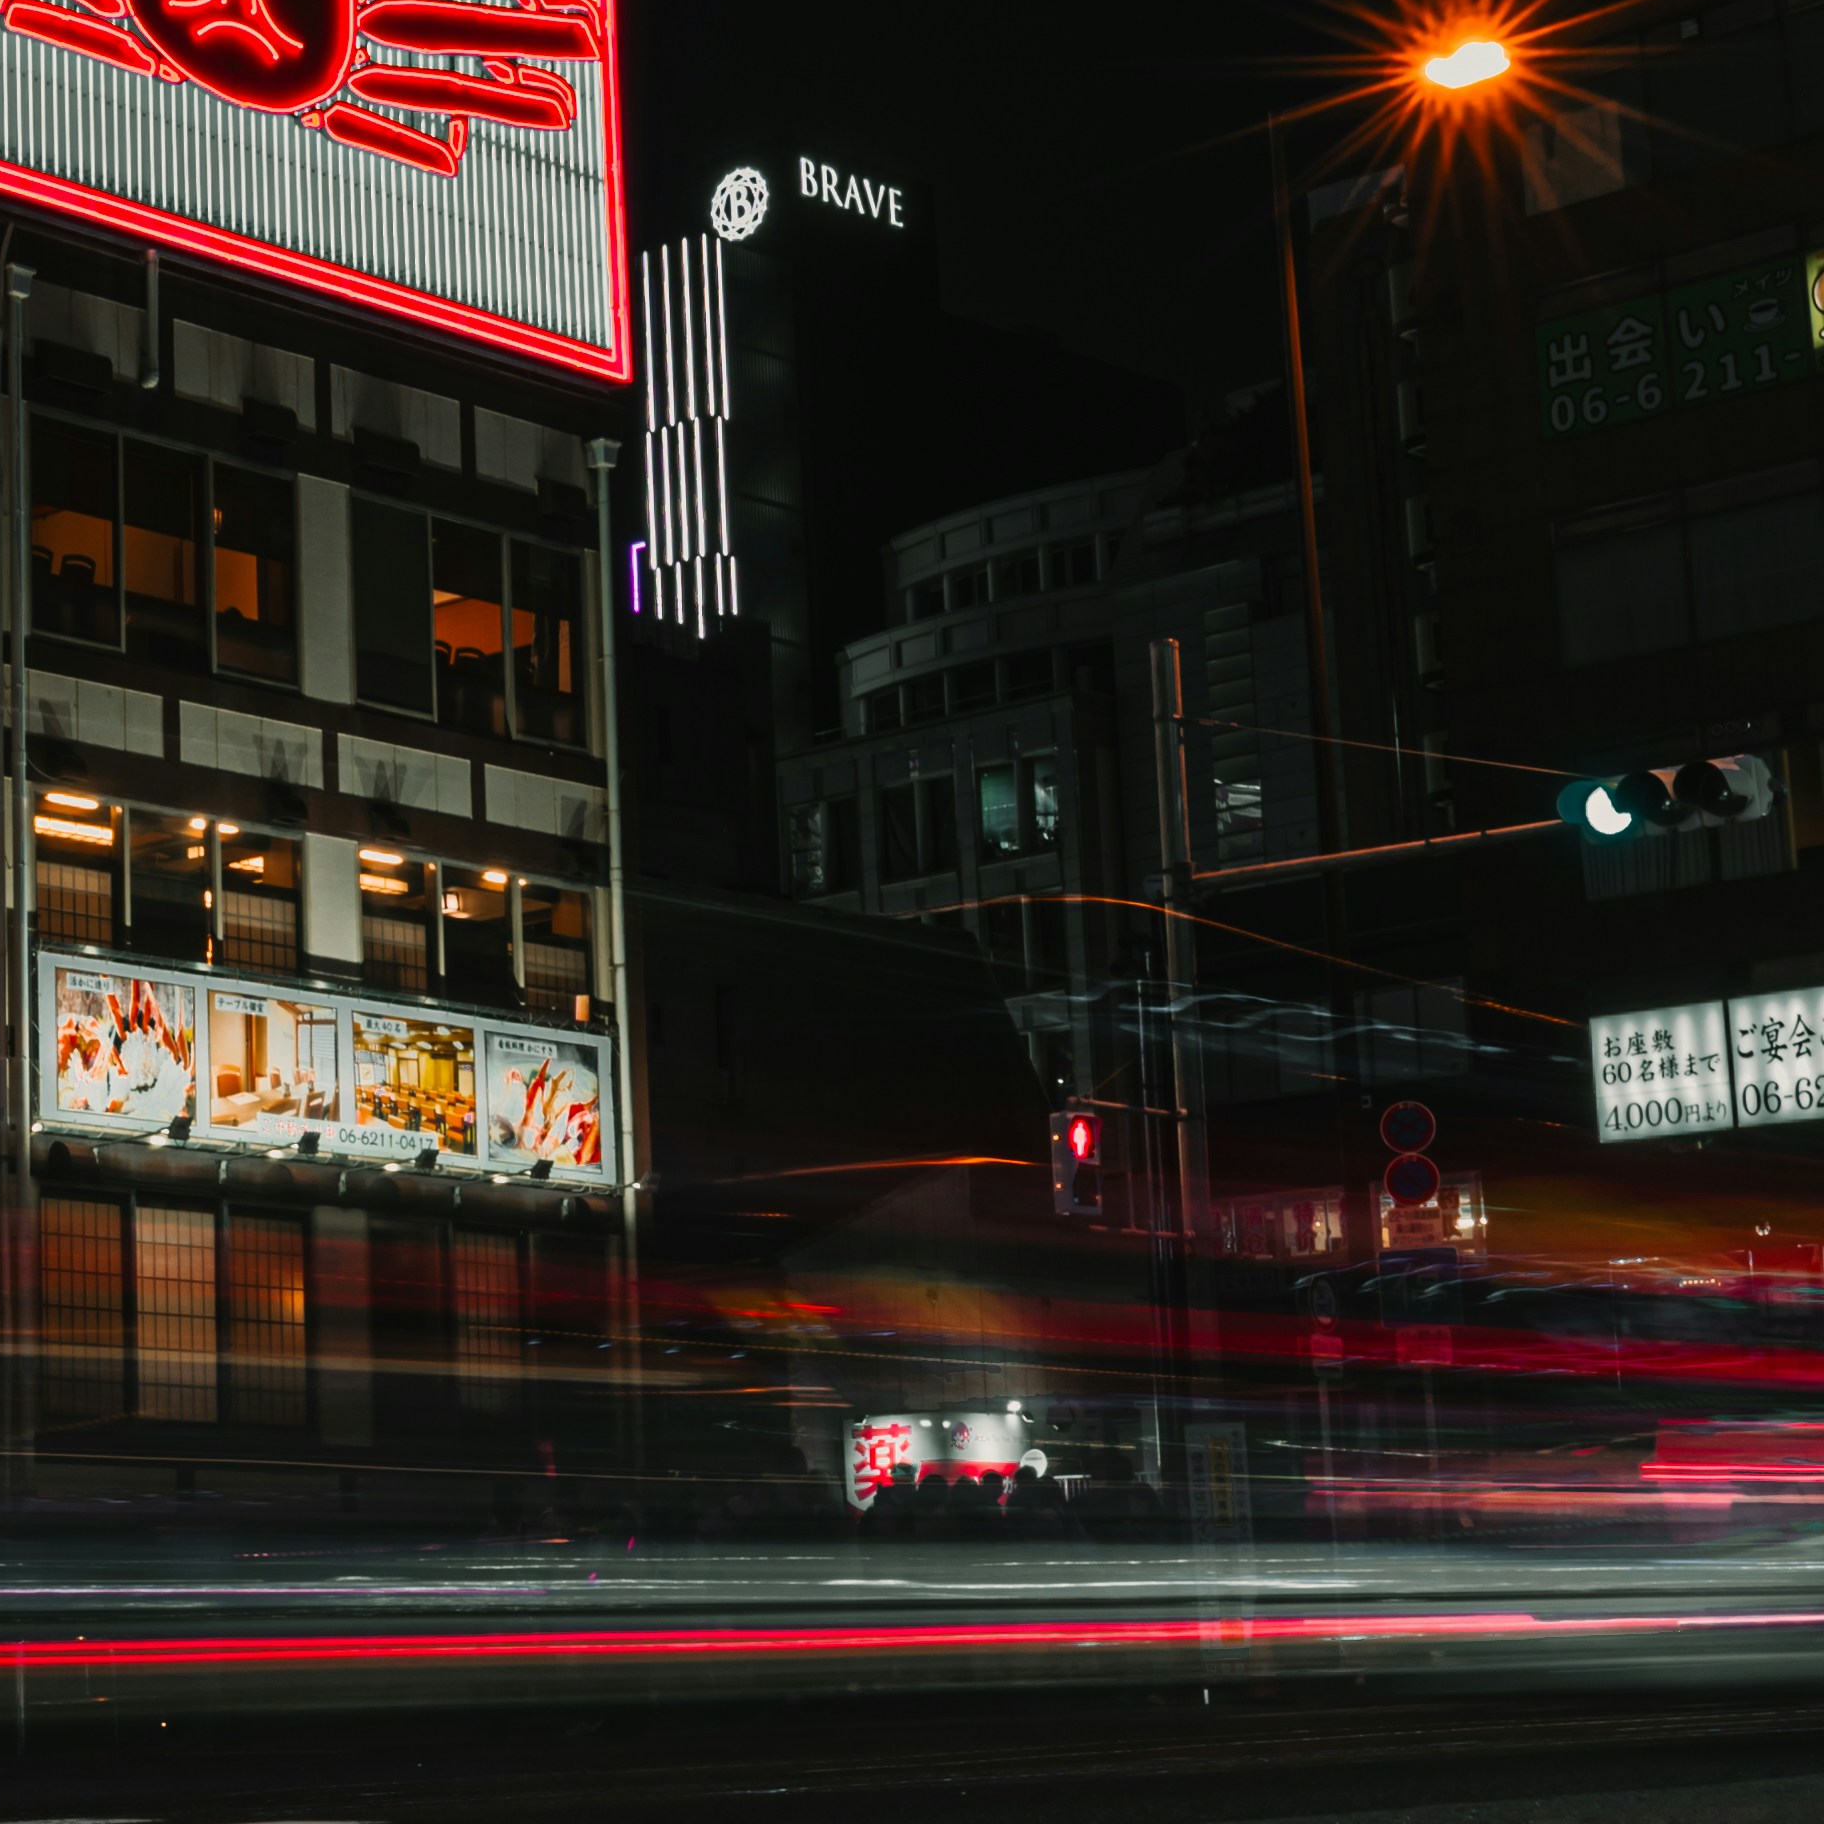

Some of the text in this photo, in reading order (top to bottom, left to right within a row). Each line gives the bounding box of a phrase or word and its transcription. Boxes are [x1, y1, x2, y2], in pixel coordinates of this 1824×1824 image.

[799, 156, 905, 228] BRAVE
[1547, 304, 1726, 388] 出会い
[1603, 1028, 1675, 1058] お座敷
[1736, 1013, 1824, 1064] ご宴会
[1602, 1052, 1721, 1085] 60名様まで
[1604, 1097, 1727, 1132] 4,000円より
[338, 1127, 434, 1150] 06-6211-0417
